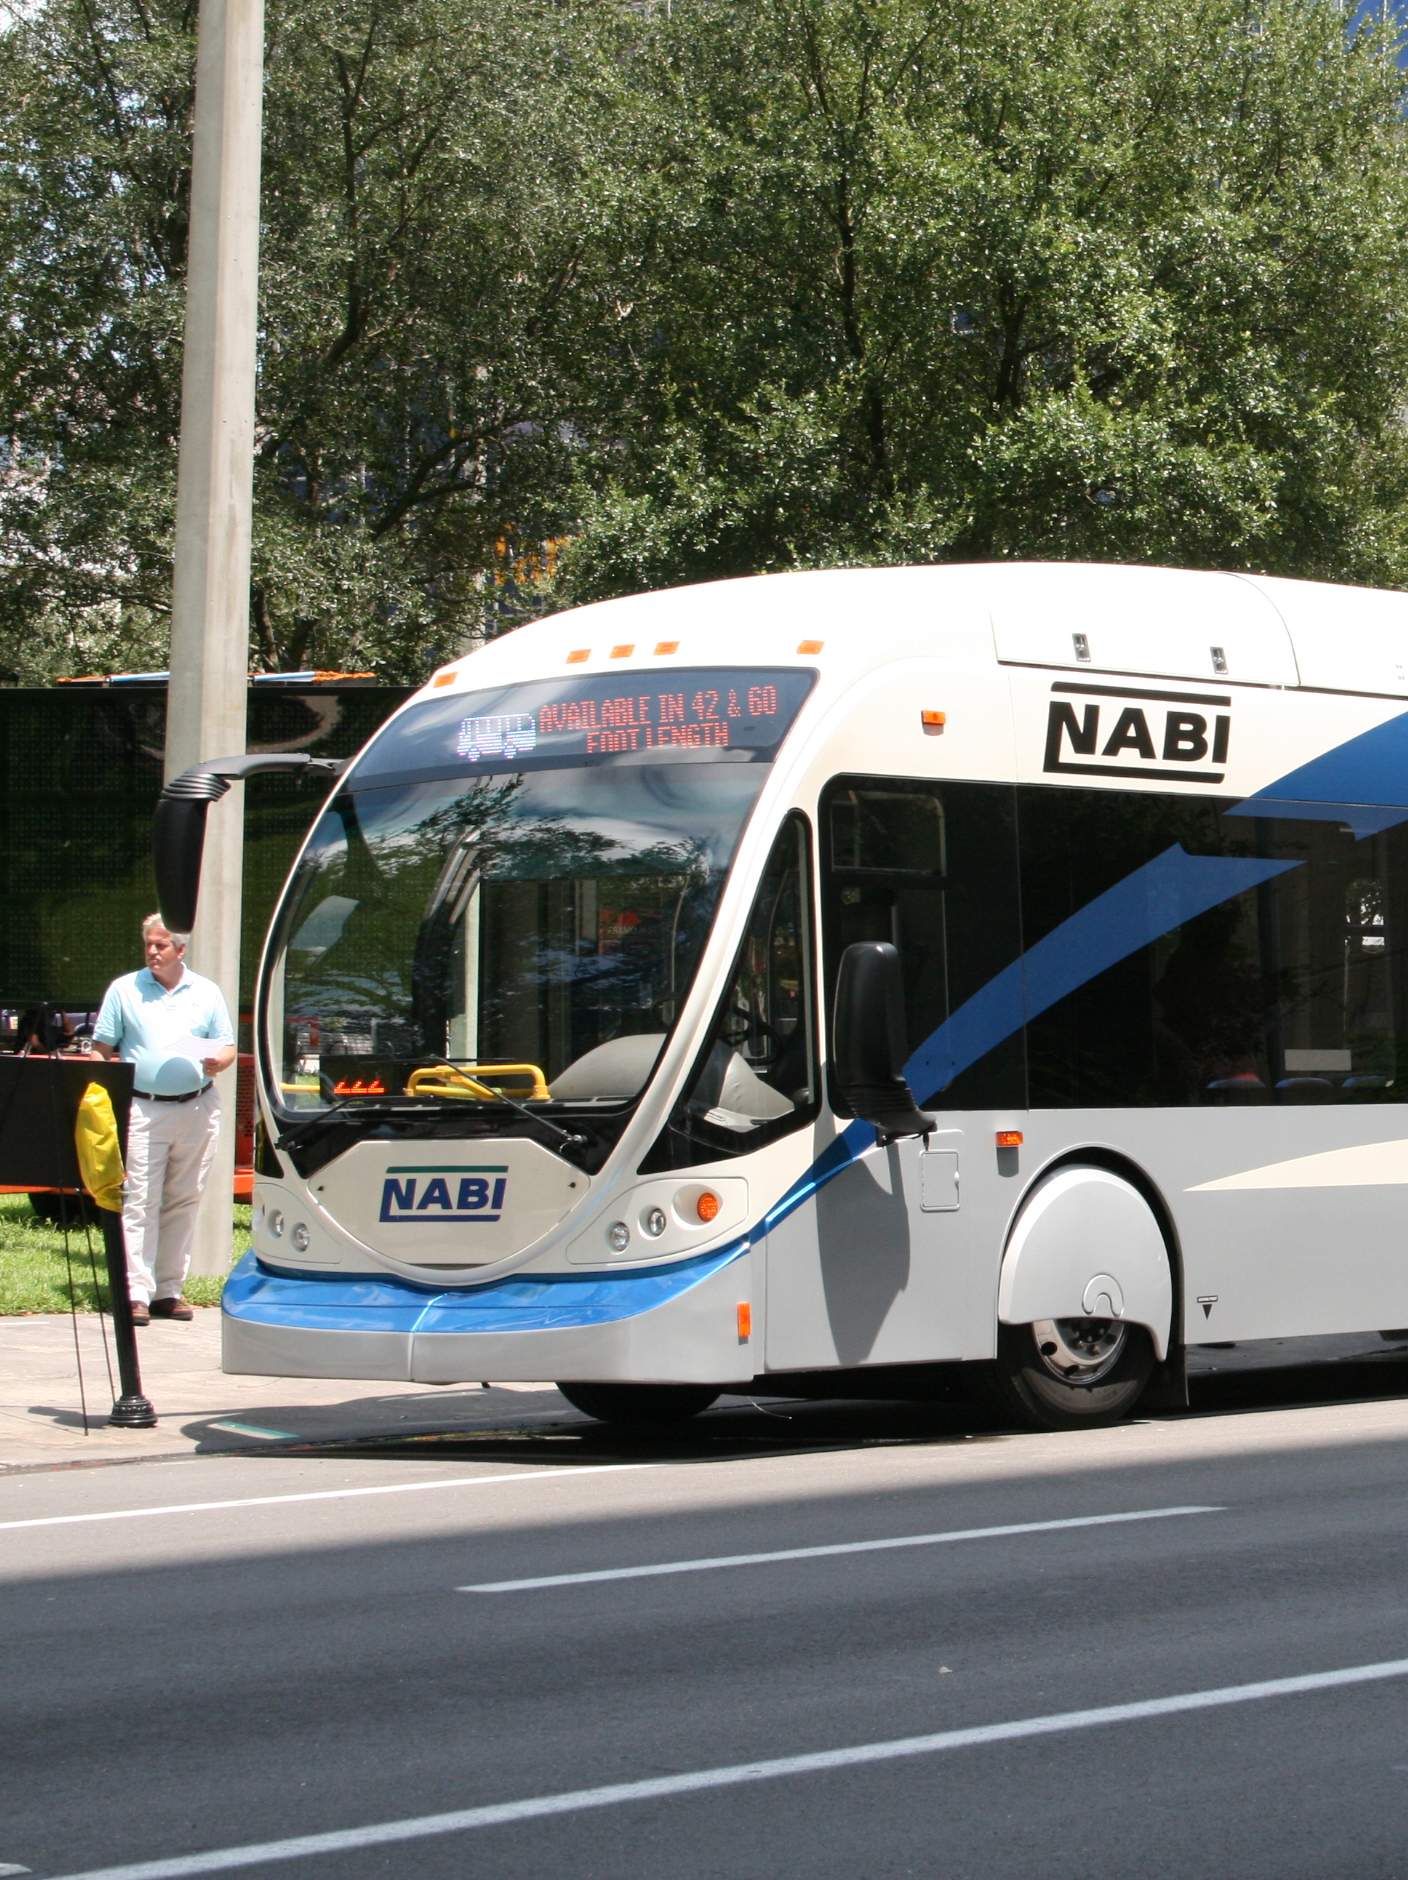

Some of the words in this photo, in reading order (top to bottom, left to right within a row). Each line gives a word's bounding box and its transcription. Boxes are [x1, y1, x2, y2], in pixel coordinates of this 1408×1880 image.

[538, 696, 651, 733] AVAILABLE
[658, 693, 685, 723] IN
[691, 690, 720, 720] 42
[727, 688, 742, 718] &
[748, 686, 777, 716] 60
[1043, 700, 1231, 773] NABI
[379, 1177, 508, 1223] NABI
